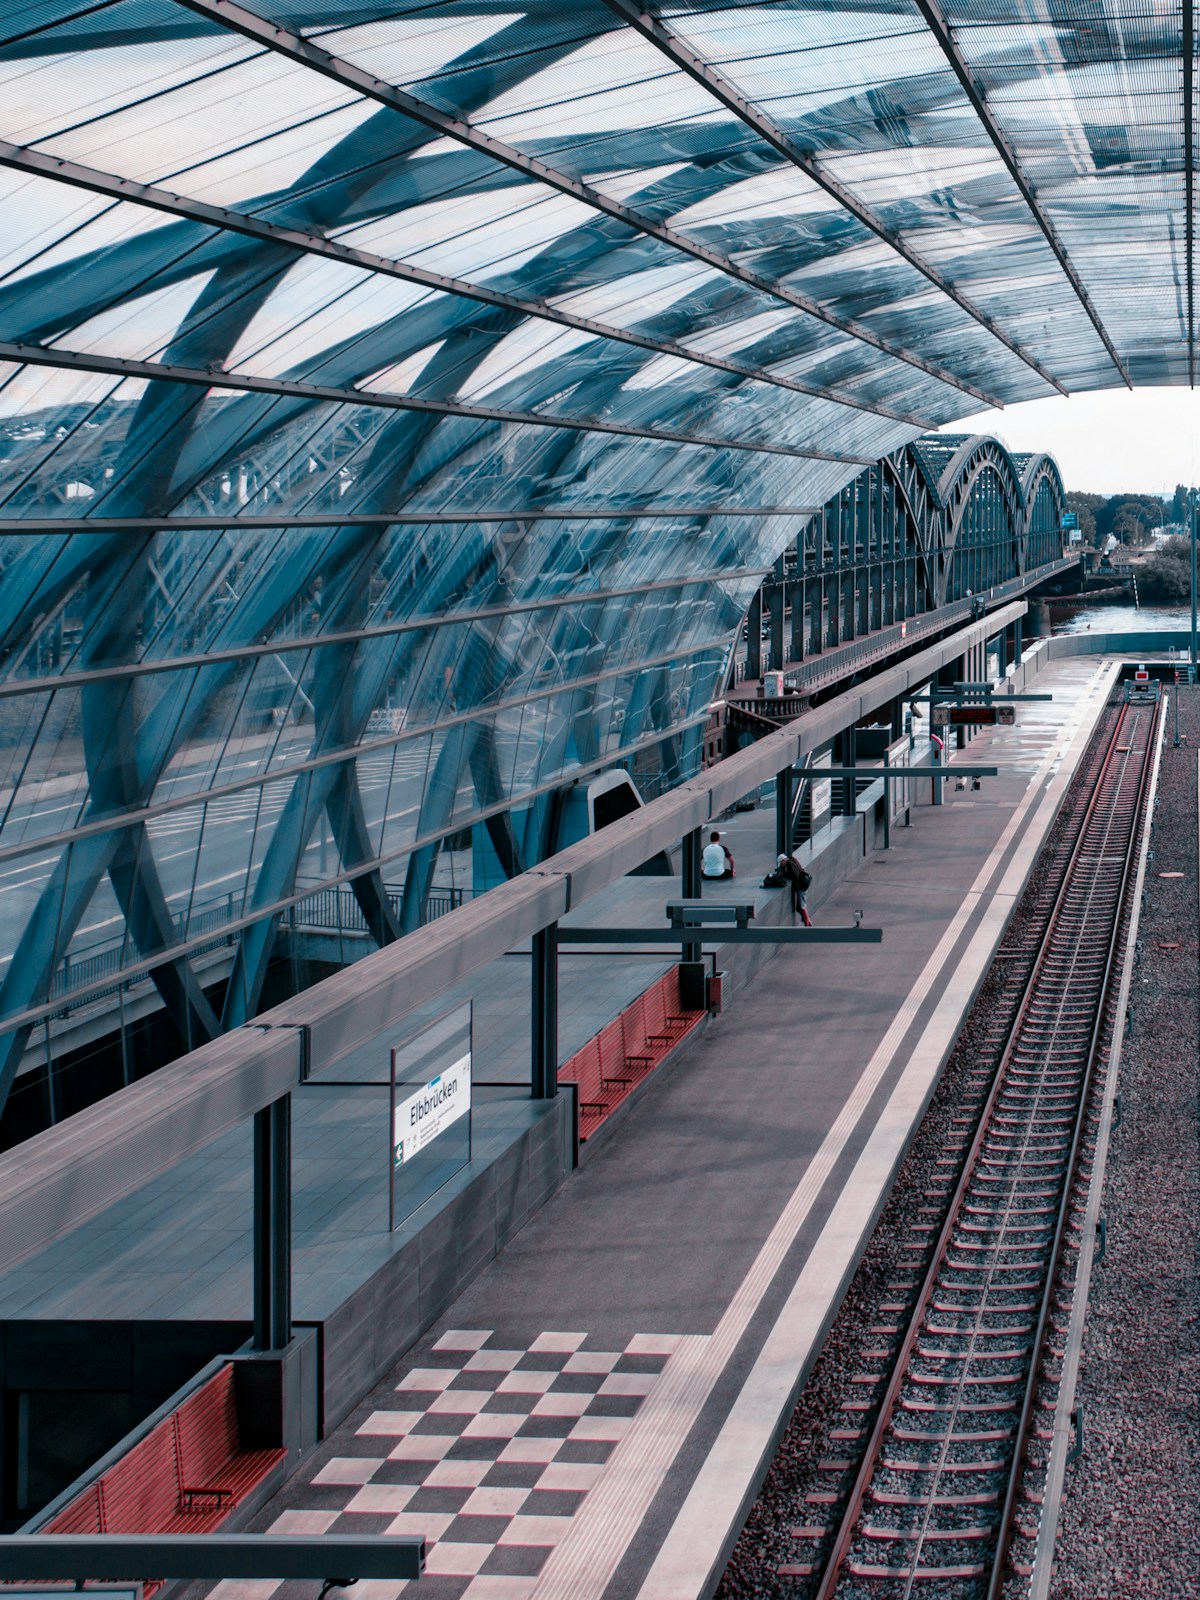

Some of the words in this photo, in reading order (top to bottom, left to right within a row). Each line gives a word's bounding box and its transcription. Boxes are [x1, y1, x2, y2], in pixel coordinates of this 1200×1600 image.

[1147, 852, 1154, 860] 4
[1136, 942, 1143, 952] 3
[410, 1078, 458, 1127] Elbbrücken
